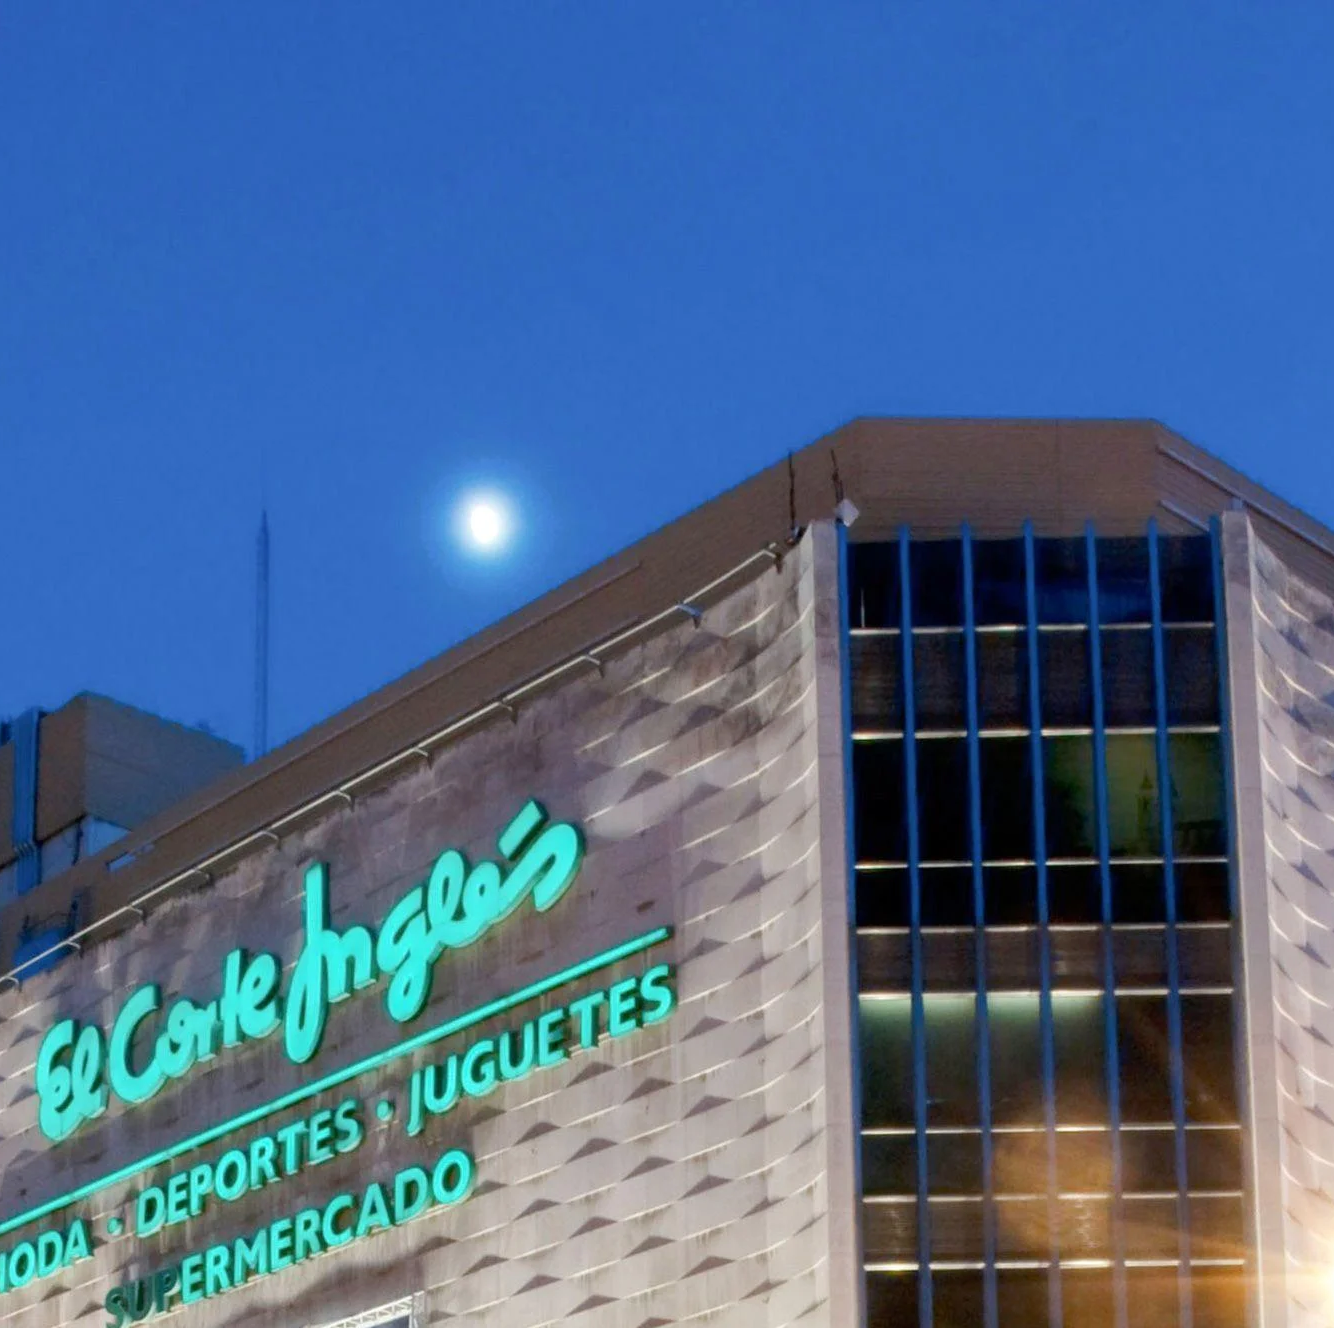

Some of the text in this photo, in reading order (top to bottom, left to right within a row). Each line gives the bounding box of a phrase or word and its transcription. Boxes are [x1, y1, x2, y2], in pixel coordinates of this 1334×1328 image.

[36, 799, 584, 1141] El Corte Inglés
[135, 1098, 364, 1238] DEPORTES
[407, 964, 677, 1136] JUGUETES
